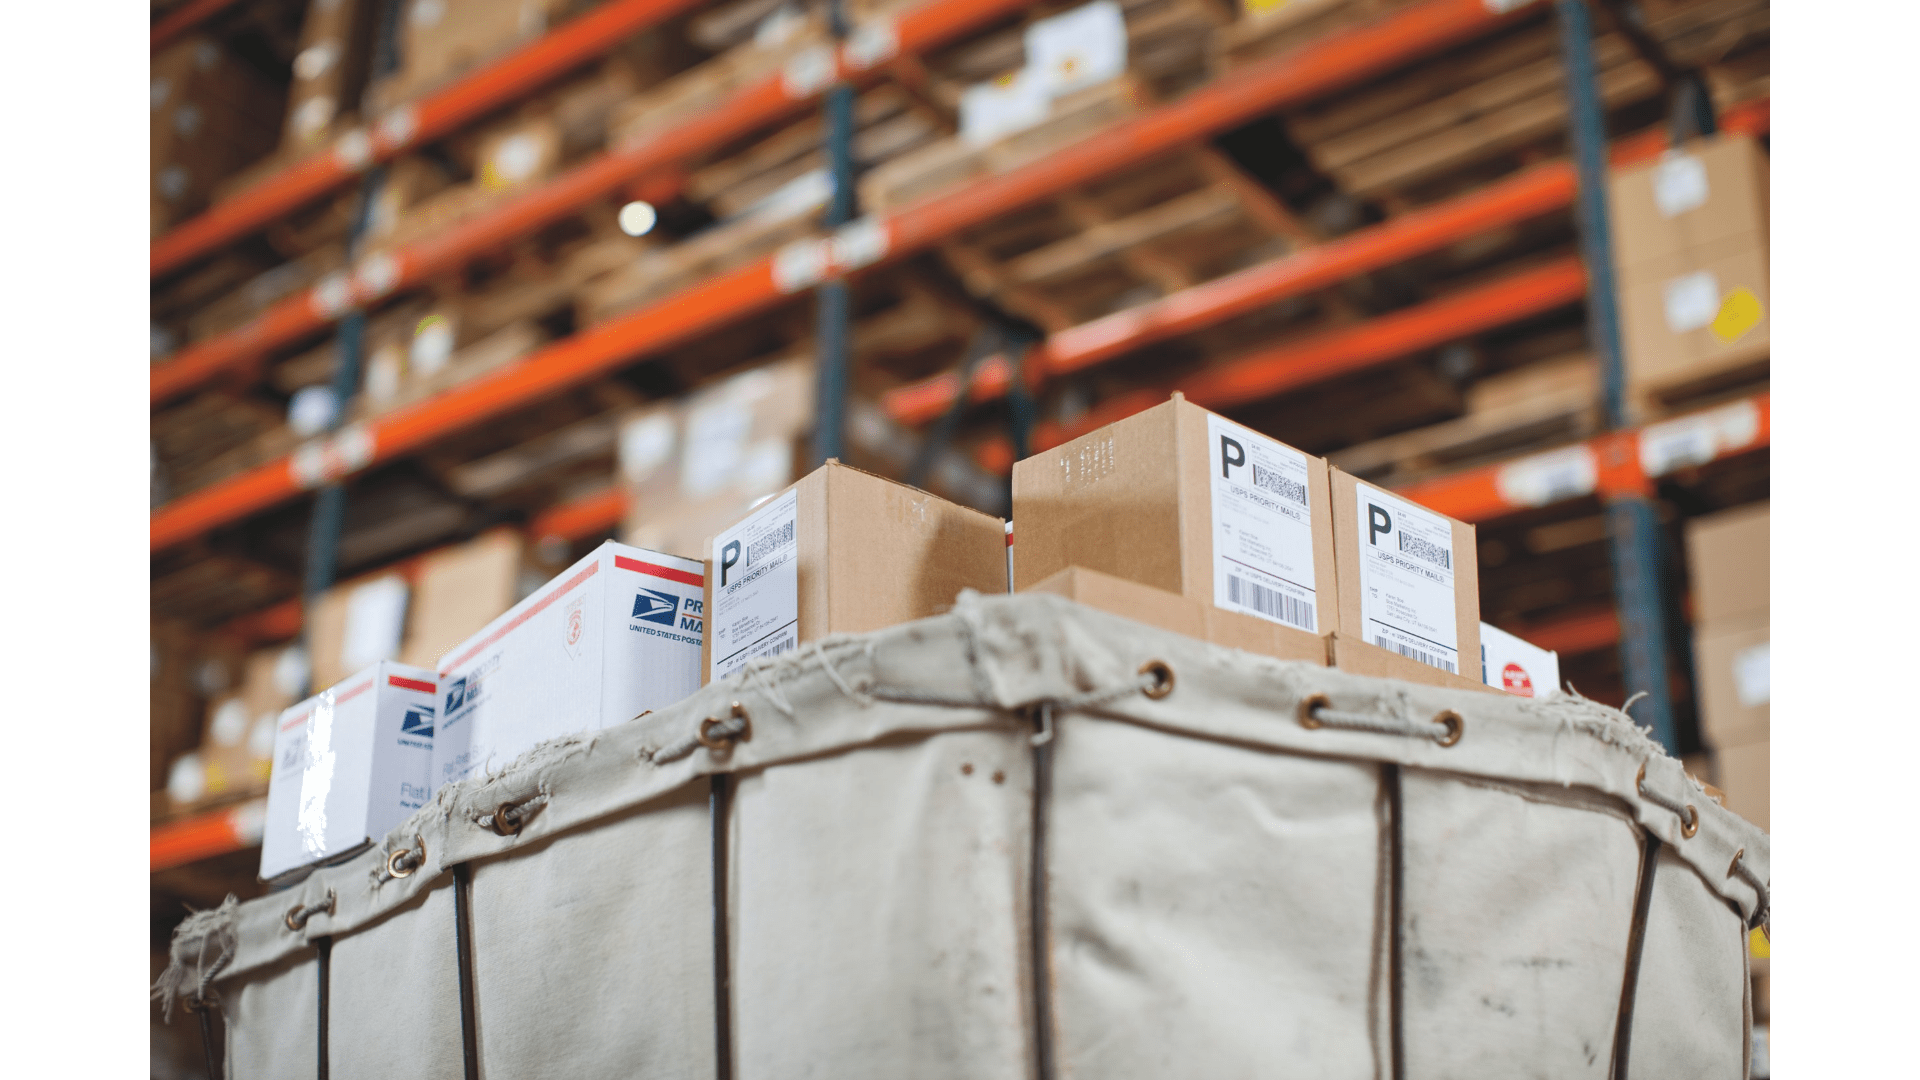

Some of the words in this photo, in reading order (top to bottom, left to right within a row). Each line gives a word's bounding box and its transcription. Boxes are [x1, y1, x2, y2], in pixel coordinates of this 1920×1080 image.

[1221, 434, 1245, 479] P
[1230, 485, 1248, 498] USPS
[1250, 493, 1279, 511] PRIORITY
[1368, 503, 1392, 546] P
[721, 539, 741, 588] P
[1378, 551, 1394, 564] USPS
[1396, 558, 1424, 575] PRIORITY
[727, 580, 742, 595] USPS
[743, 564, 768, 585] PRIORITY
[630, 624, 656, 635] UNITED
[656, 630, 681, 641] STATES
